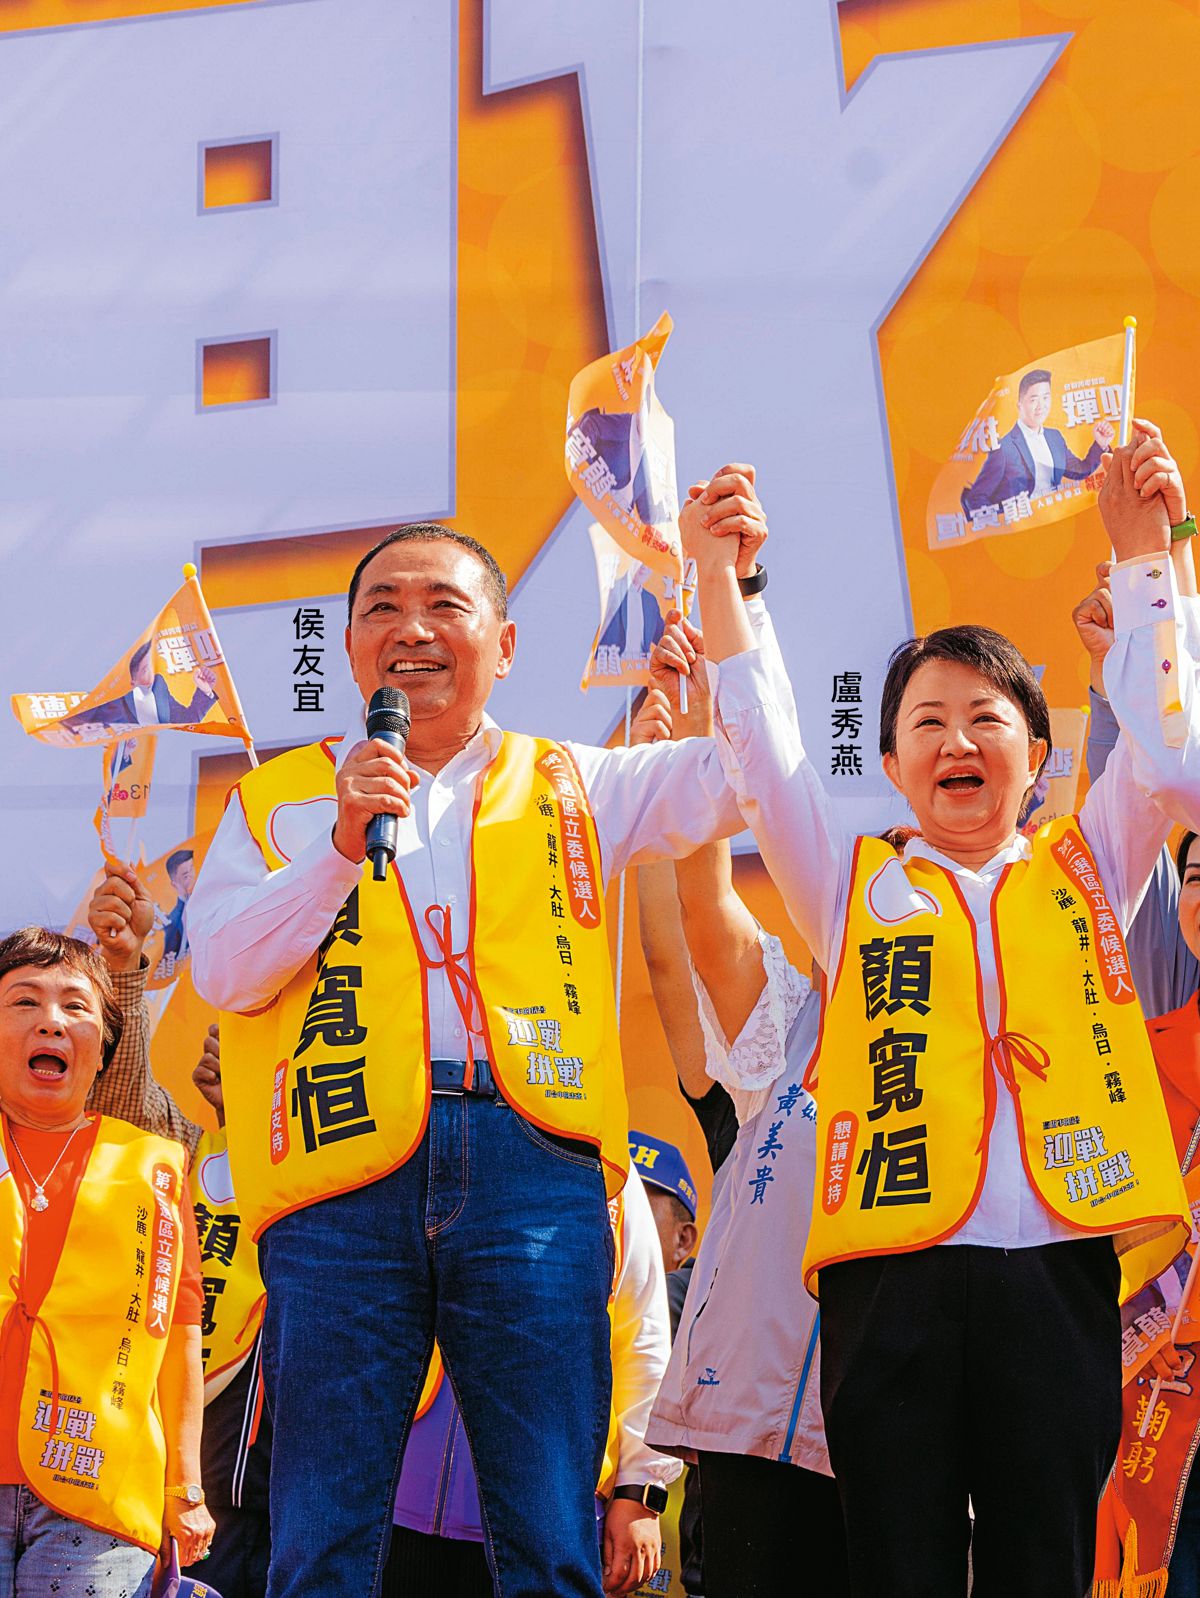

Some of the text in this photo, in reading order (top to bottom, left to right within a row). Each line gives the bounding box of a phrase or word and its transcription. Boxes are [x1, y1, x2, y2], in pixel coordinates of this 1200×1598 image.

[526, 1051, 584, 1088] 拼戰
[855, 934, 935, 1210] 顏寬恒
[827, 1120, 852, 1206] 懇請支持
[1043, 1126, 1109, 1170] 迎戰
[1064, 1149, 1135, 1203] 拼戰
[39, 1438, 105, 1480] 拼戰
